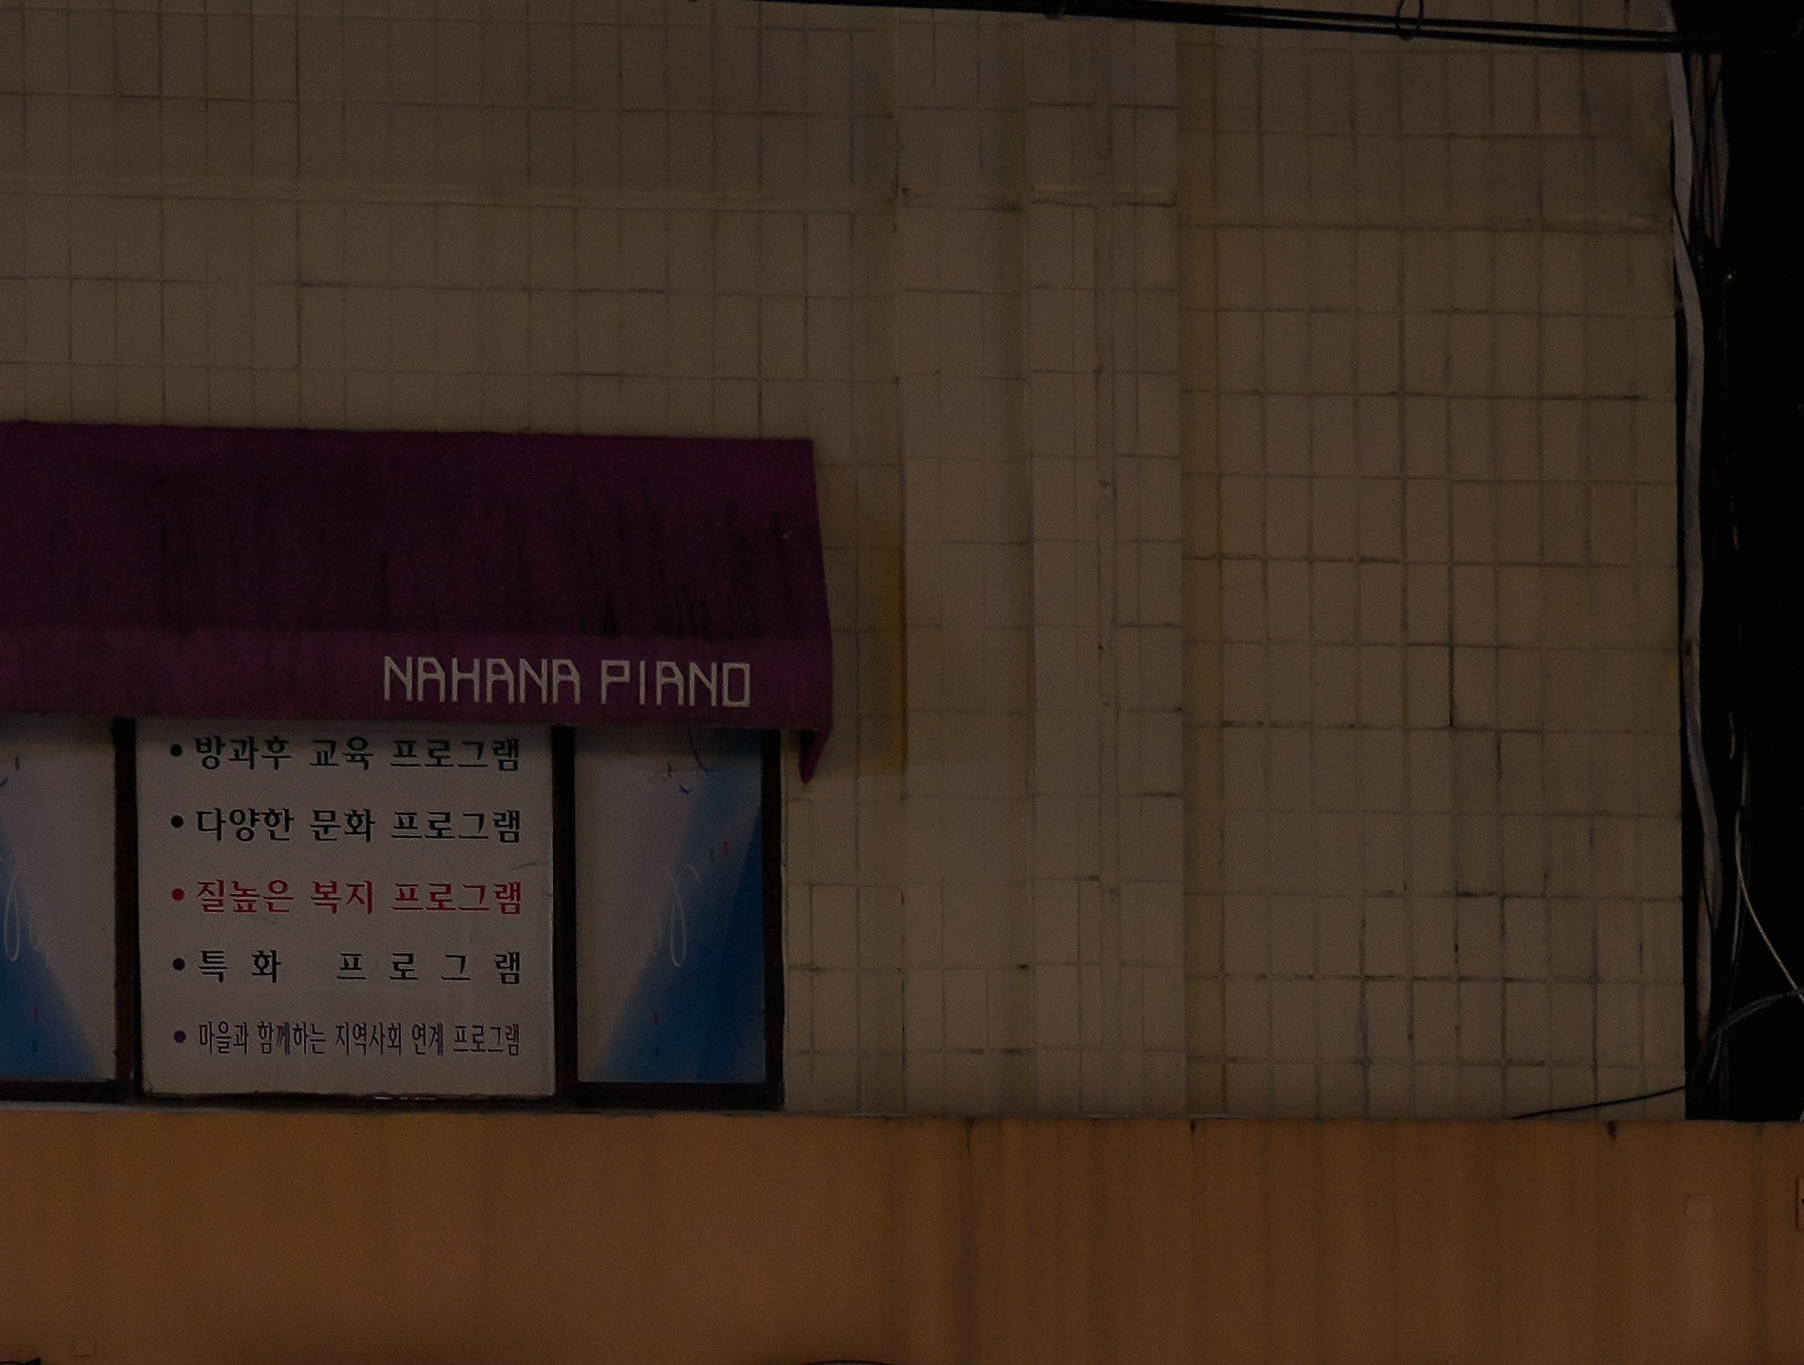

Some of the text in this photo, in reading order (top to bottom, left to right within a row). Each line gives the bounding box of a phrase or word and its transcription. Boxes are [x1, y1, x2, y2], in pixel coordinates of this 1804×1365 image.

[383, 655, 751, 708] NAHANA PIANO
[195, 735, 521, 771] 방과후 교육 프로그램
[195, 806, 522, 843] 다양한 문화 프로그램
[195, 878, 523, 915] 질높은 복지 프로그램
[197, 1021, 521, 1057] 마을과 함께하는 지역사회 연계 프로그램
